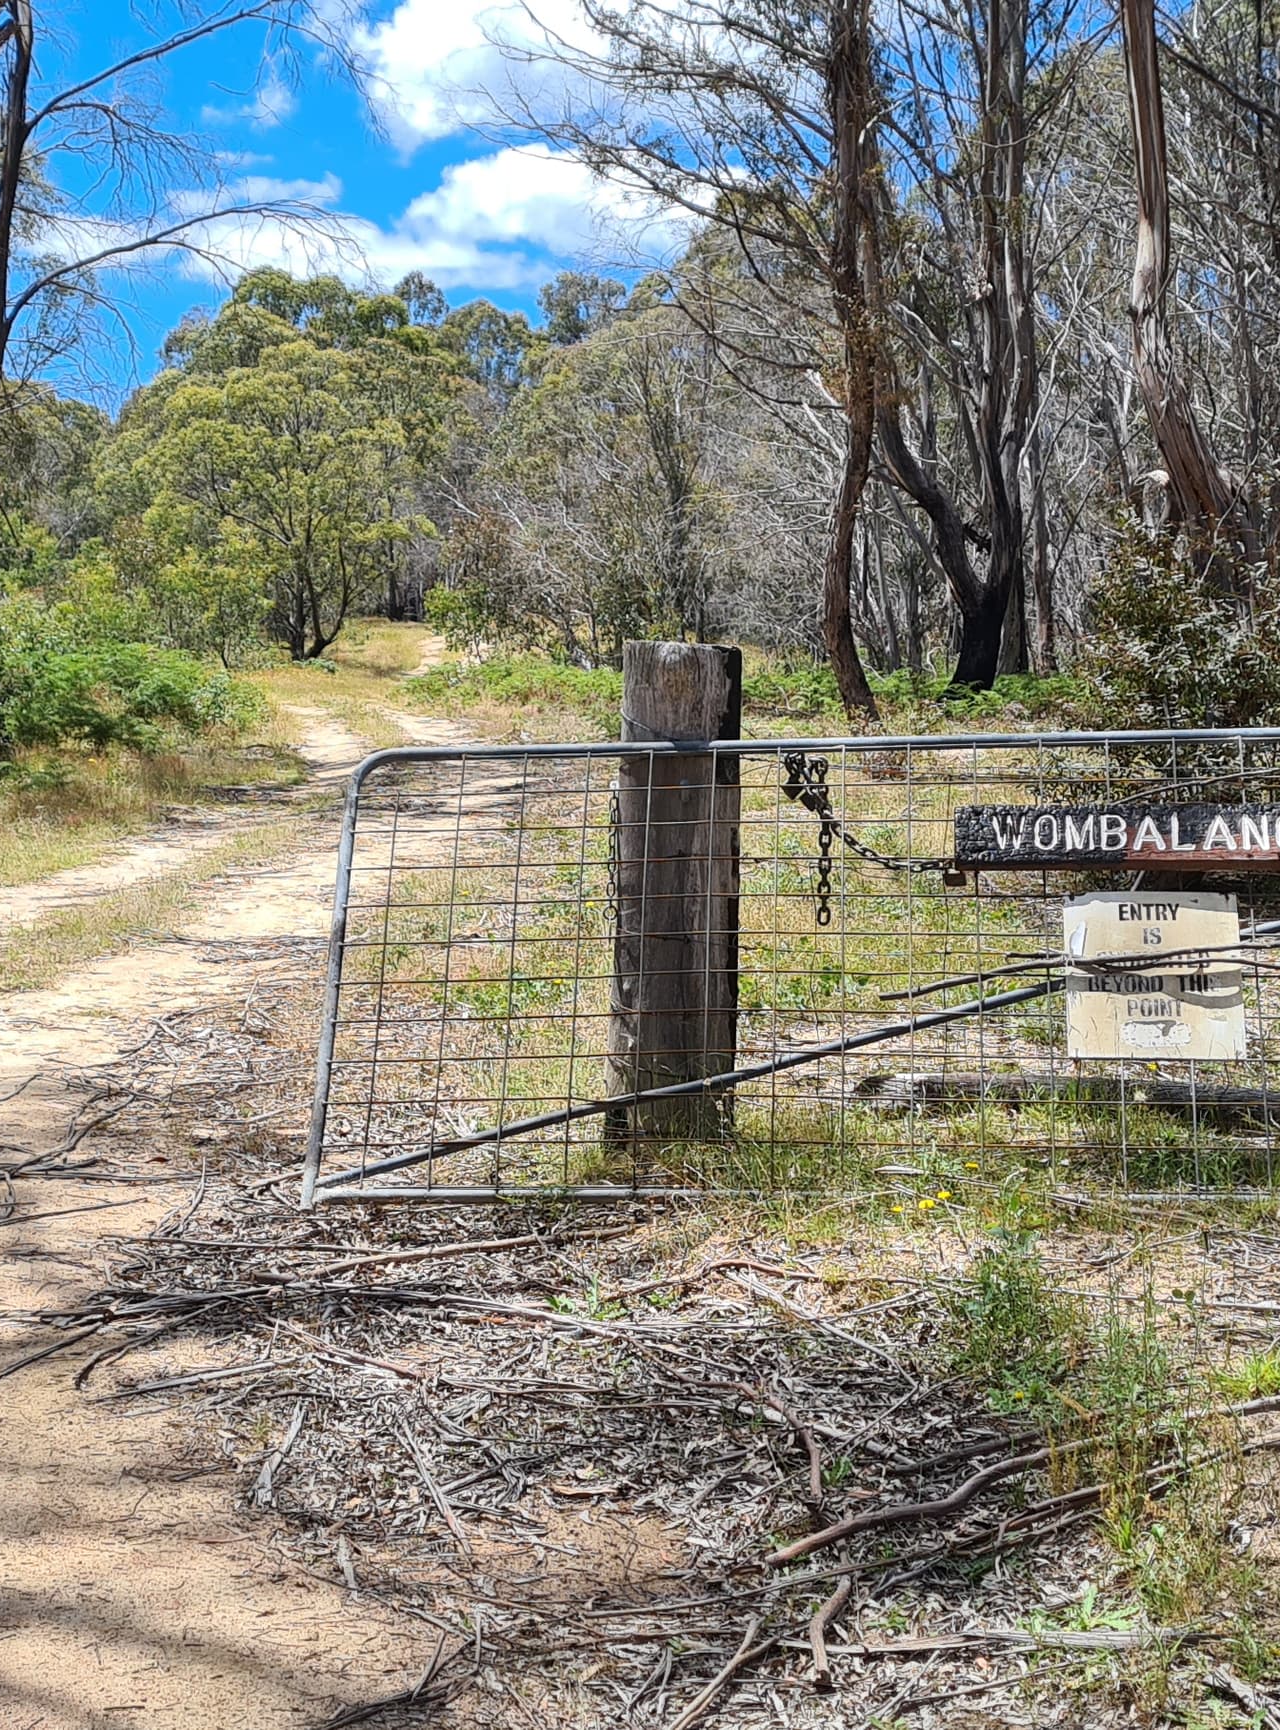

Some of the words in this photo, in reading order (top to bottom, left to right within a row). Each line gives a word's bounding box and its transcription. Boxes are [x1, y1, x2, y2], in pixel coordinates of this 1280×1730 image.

[1119, 903, 1180, 921] ENTRY
[1143, 927, 1162, 945] IS
[1088, 975, 1164, 993] BEYOND
[1127, 998, 1183, 1017] POINT
